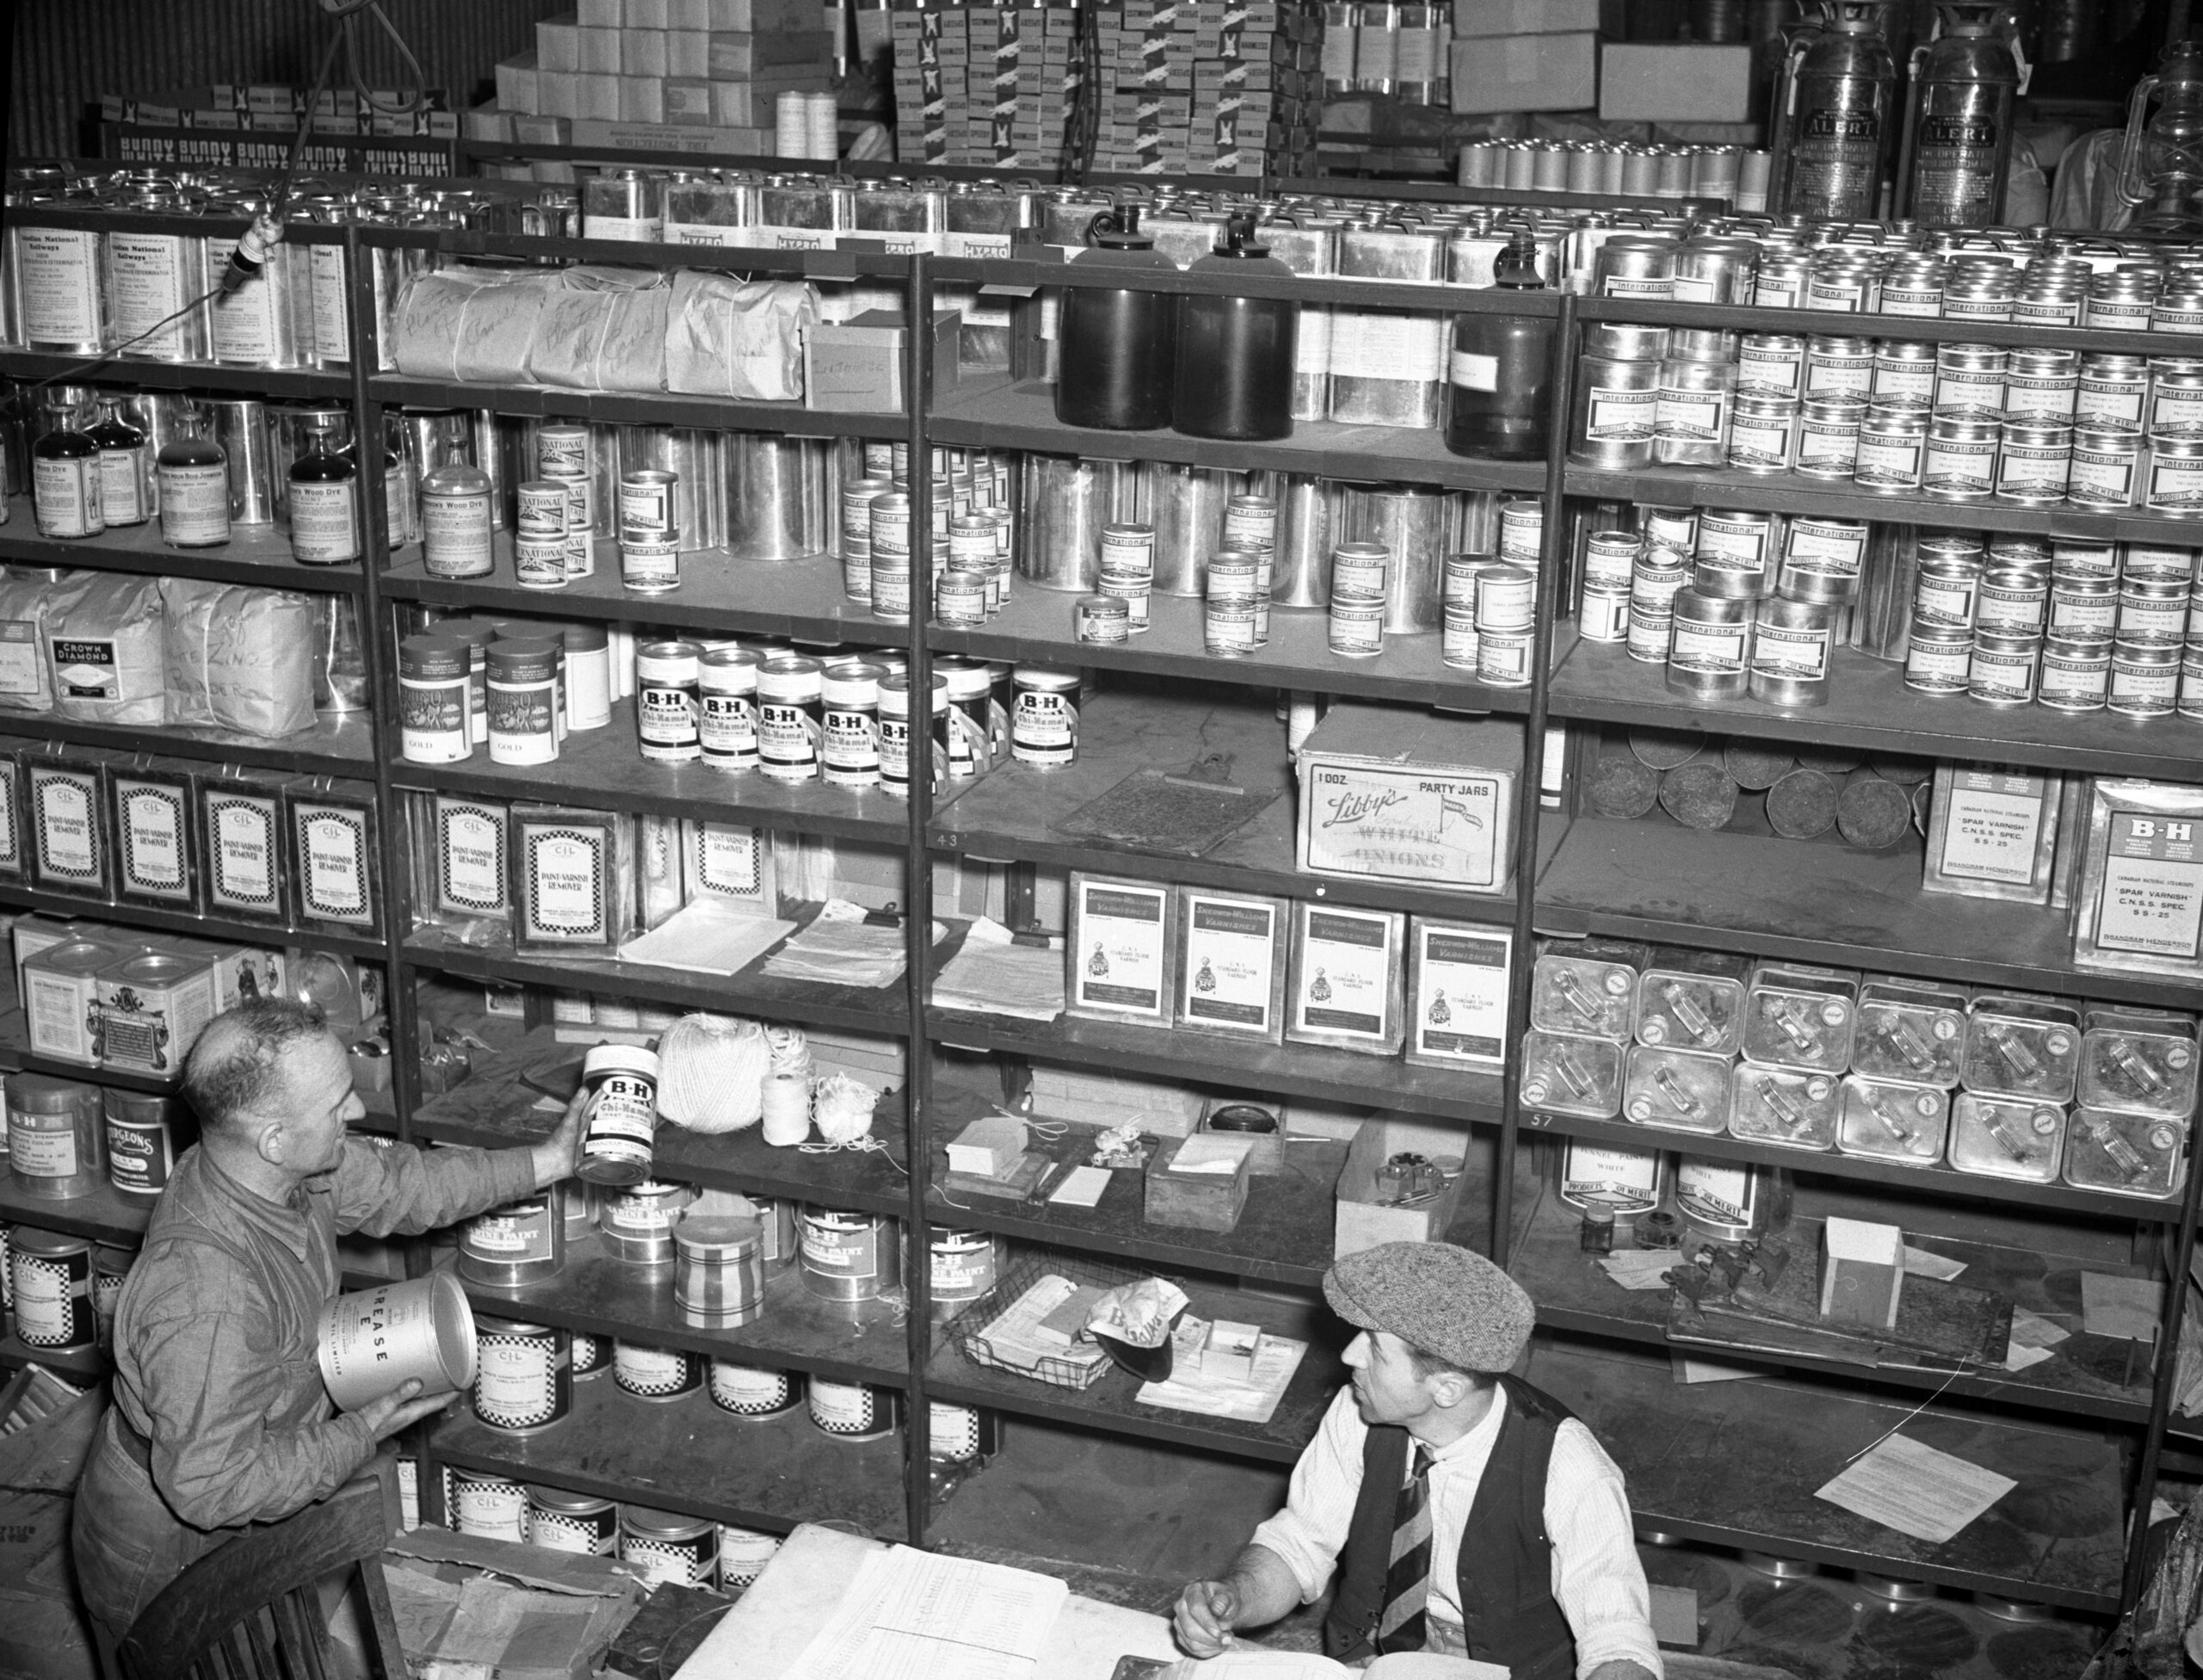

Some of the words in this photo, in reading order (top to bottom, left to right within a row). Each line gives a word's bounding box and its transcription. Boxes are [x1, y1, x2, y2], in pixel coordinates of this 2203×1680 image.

[121, 138, 174, 151] BUNNY
[179, 140, 231, 155] BUNNY
[238, 143, 287, 159] BUNNY
[2114, 418, 2136, 429] MERIT
[1692, 426, 1712, 435] MERIT
[565, 455, 584, 468] MERIT
[2101, 489, 2123, 499] MERIT
[447, 501, 466, 510] WOOD
[542, 515, 562, 528] MERIT
[546, 565, 565, 578] MERIT
[1942, 612, 1962, 622] MERIT
[63, 643, 102, 652] CROWN
[58, 652, 108, 661] DIAMOND
[1719, 657, 1737, 668] MERIT
[2005, 685, 2025, 695] MERIT
[647, 692, 681, 705] B-H
[1023, 695, 1059, 709] B-H
[707, 699, 740, 713] B-H
[763, 708, 796, 722] B-H
[828, 715, 861, 729] B-H
[409, 740, 433, 749] GOLD
[1420, 782, 1455, 795] PARTY
[1459, 786, 1488, 796] JARS
[1323, 788, 1408, 828] Libby's
[54, 824, 81, 835] REMOVER
[1358, 825, 1441, 844] WHITE
[2131, 819, 2193, 841] B-H
[139, 836, 168, 847] REMOVER
[937, 835, 957, 846] 43
[713, 843, 744, 854] REMOVER
[229, 849, 258, 860] REMOVER
[1354, 848, 1446, 868] ONIONS
[459, 856, 487, 867] REMOVER
[318, 862, 347, 873] REMOVER
[548, 881, 582, 891] REMOVER
[2161, 902, 2187, 911] SPEC.
[2103, 934, 2144, 943] BRANDRAM
[2146, 937, 2191, 948] HENDERSON
[612, 1080, 649, 1098] B-H
[1532, 1115, 1552, 1127] 57
[1597, 1163, 1625, 1171] WHITE
[1628, 1189, 1651, 1200] MERIT
[1714, 1198, 1741, 1217] MERIT
[508, 1229, 539, 1238] PAINT
[371, 1288, 388, 1362] GREASE
